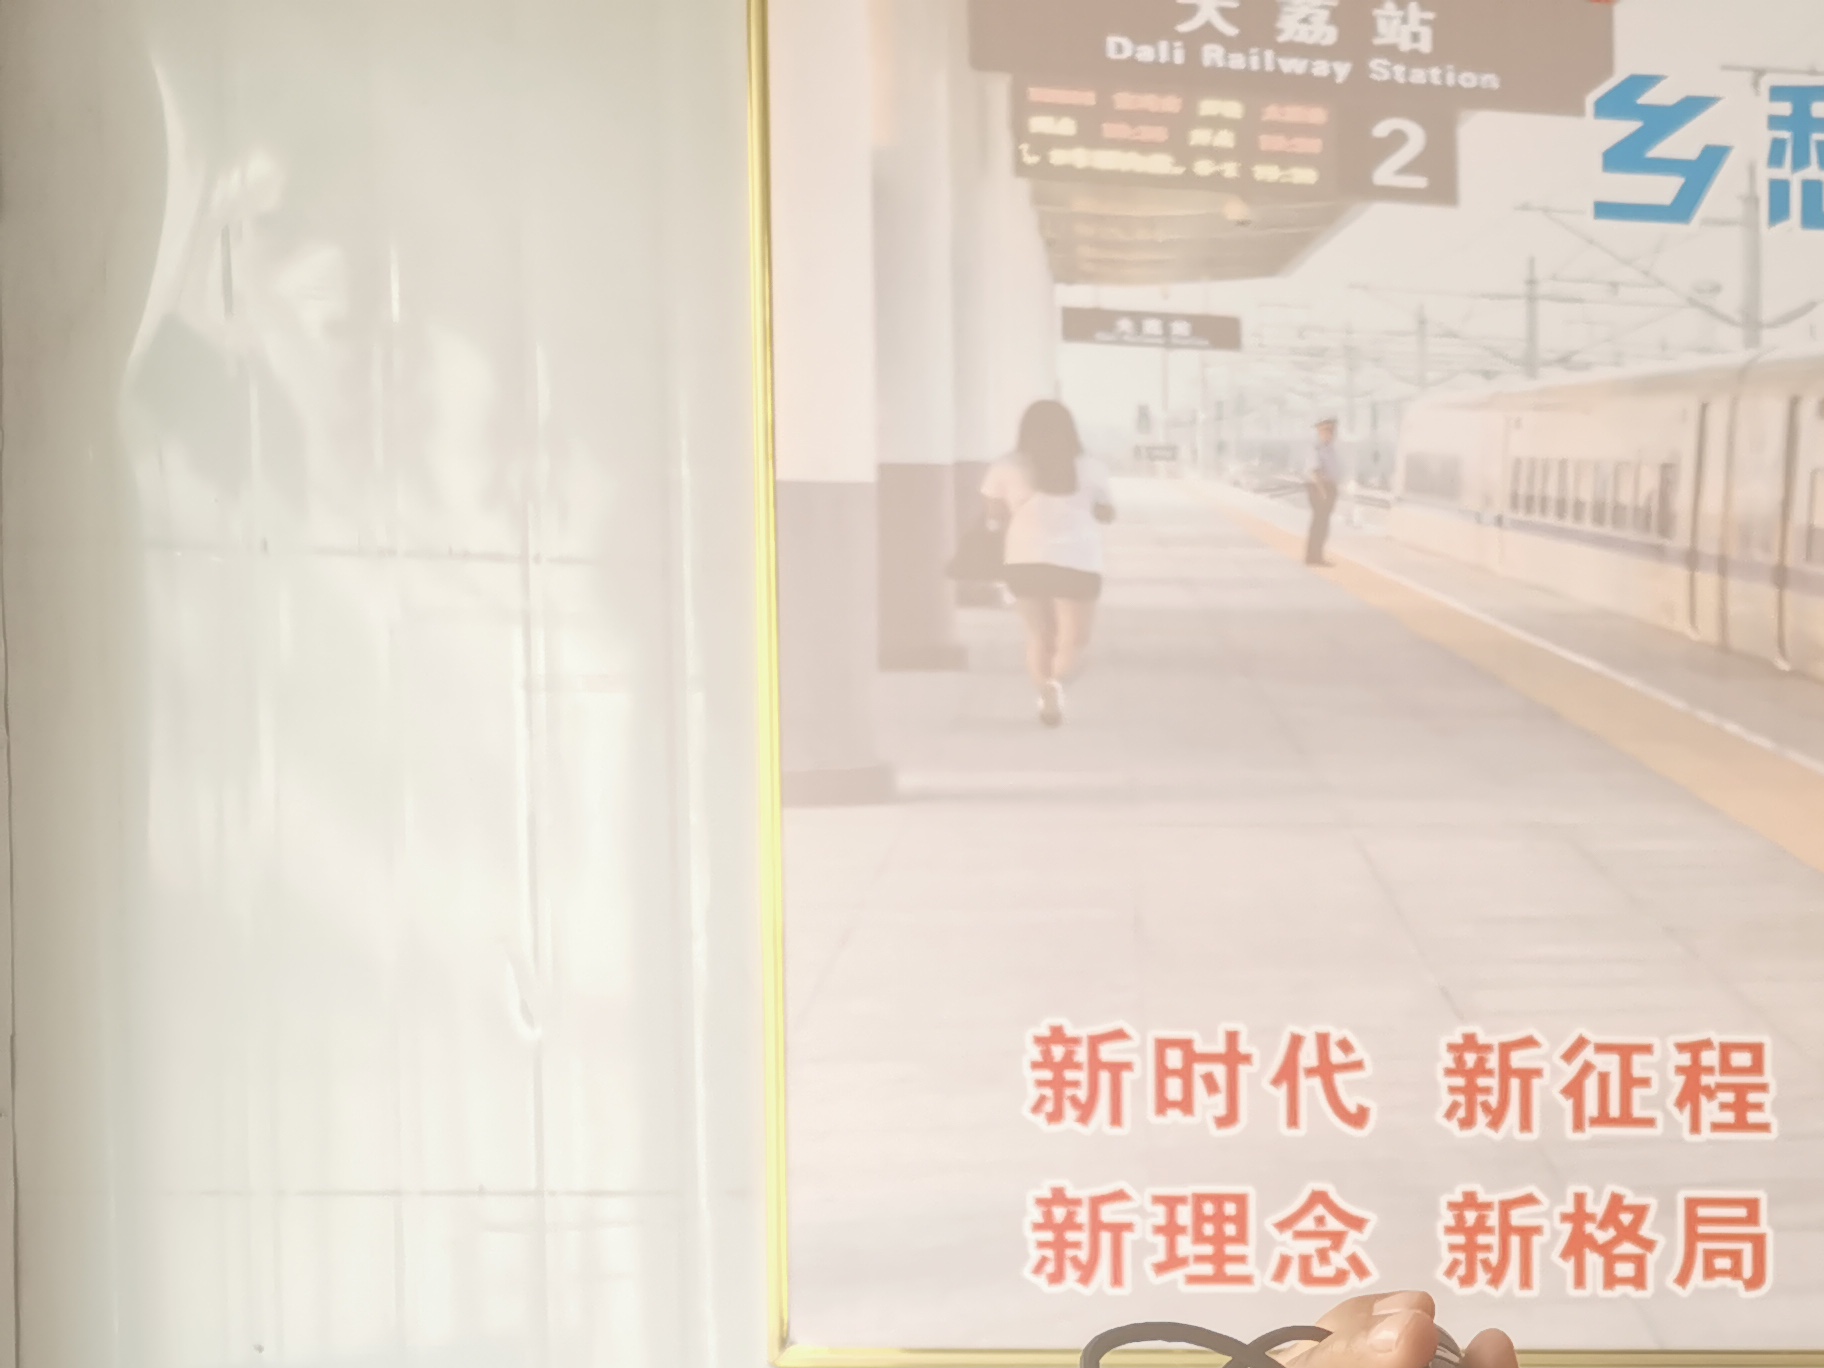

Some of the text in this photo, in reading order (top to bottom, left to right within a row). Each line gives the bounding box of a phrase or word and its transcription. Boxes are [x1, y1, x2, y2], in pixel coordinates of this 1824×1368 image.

[1105, 35, 1501, 90] Dali Railway Station
[1371, 117, 1428, 189] 2
[1029, 1026, 1372, 1131] 新时代
[1441, 1034, 1772, 1136] 新征程
[1030, 1188, 1370, 1288] 新理念
[1441, 1191, 1770, 1291] 新格局
